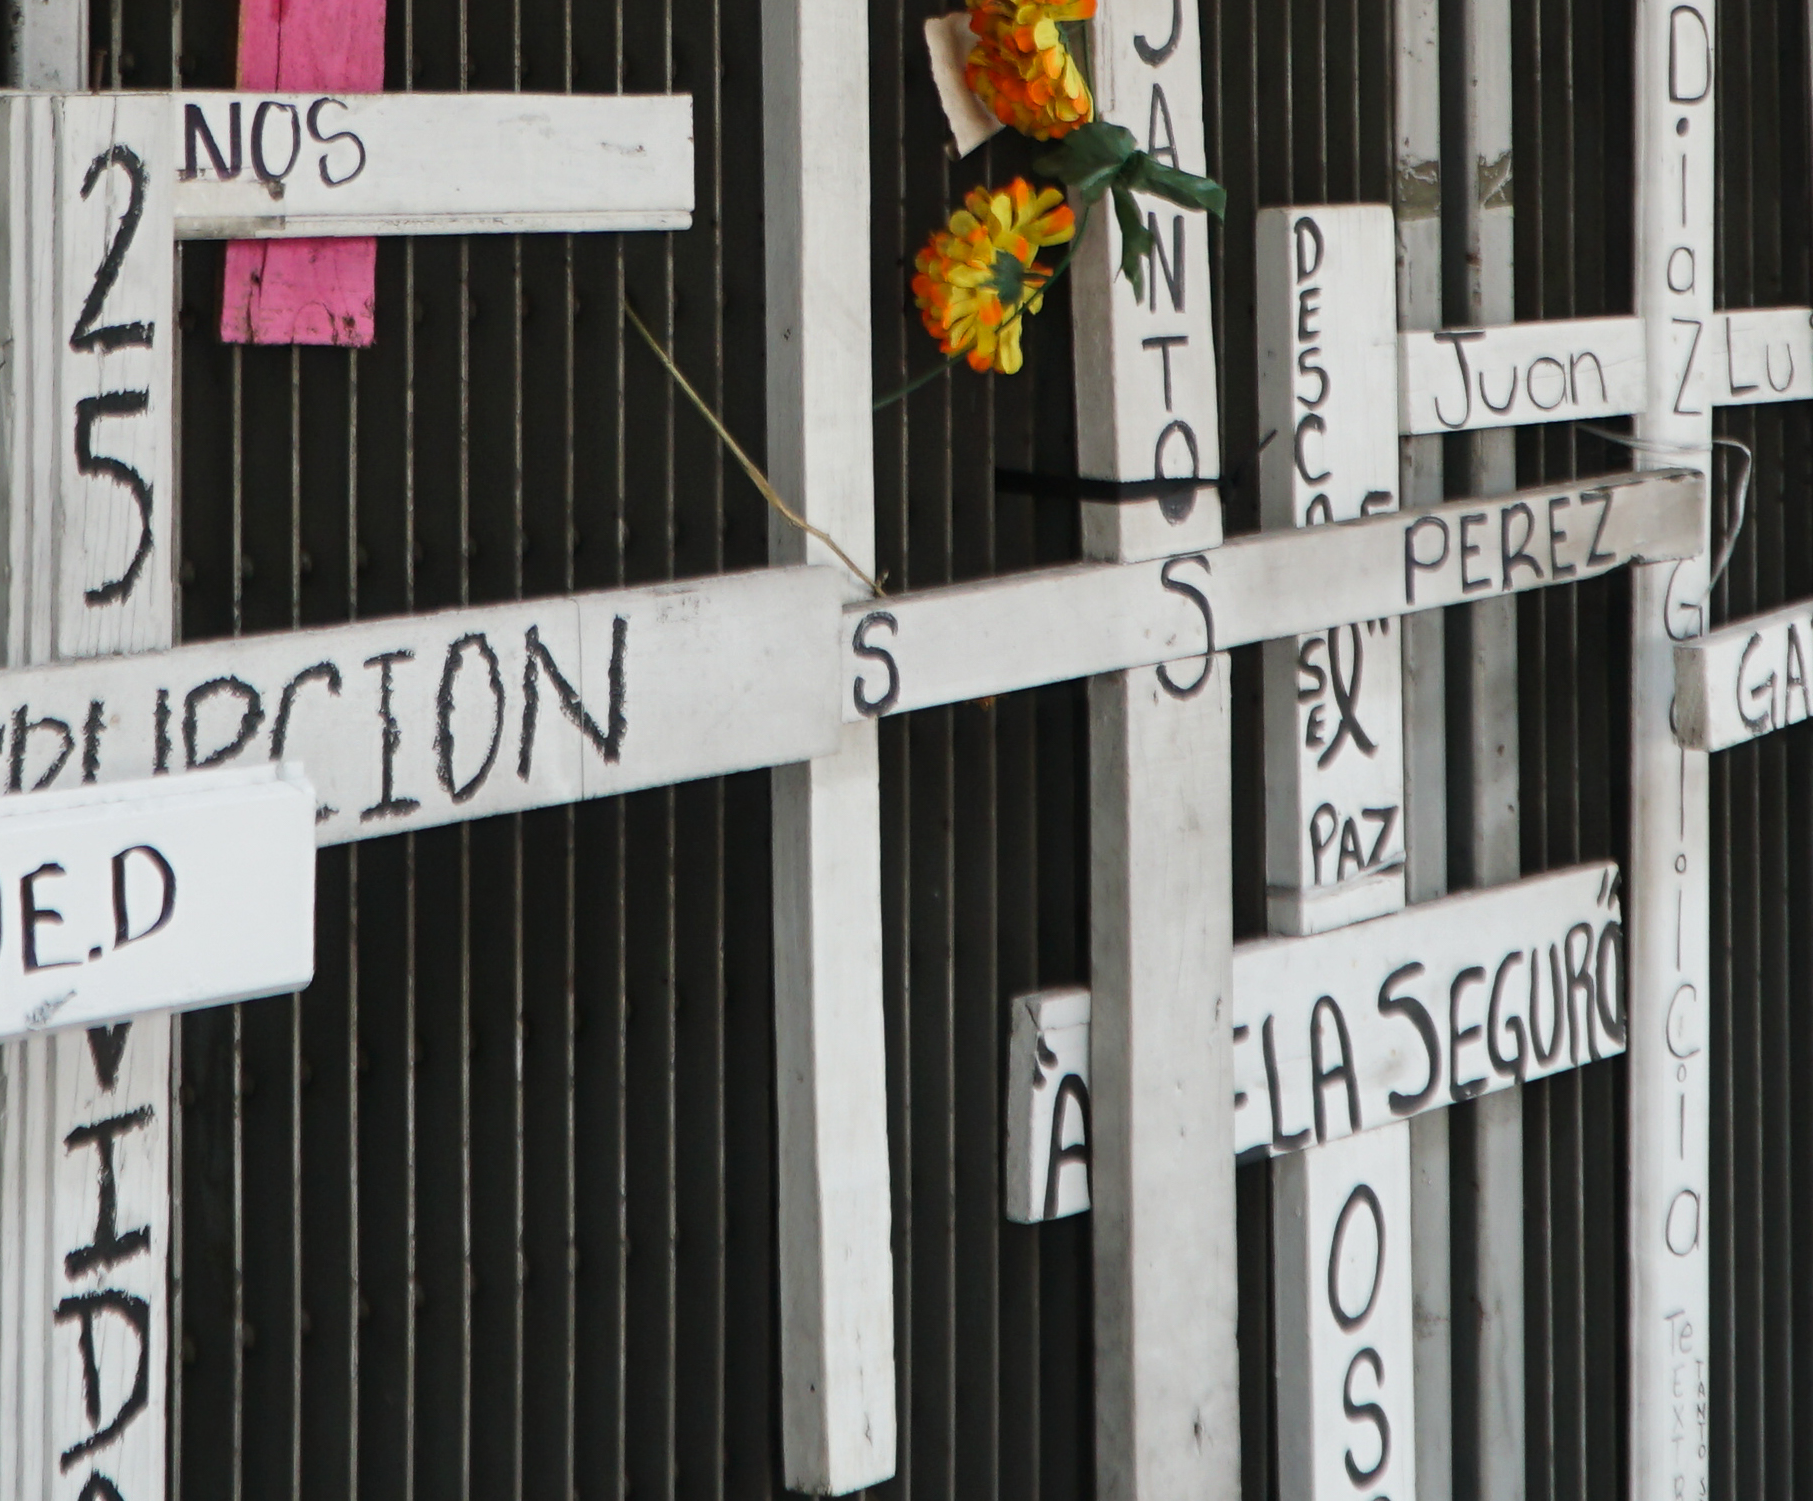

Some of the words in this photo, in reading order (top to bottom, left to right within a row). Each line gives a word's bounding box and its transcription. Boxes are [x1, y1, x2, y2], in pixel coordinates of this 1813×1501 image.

[1434, 329, 1610, 429] Juan
[1402, 487, 1618, 611] PEREZ
[1308, 801, 1402, 886] PAZ
